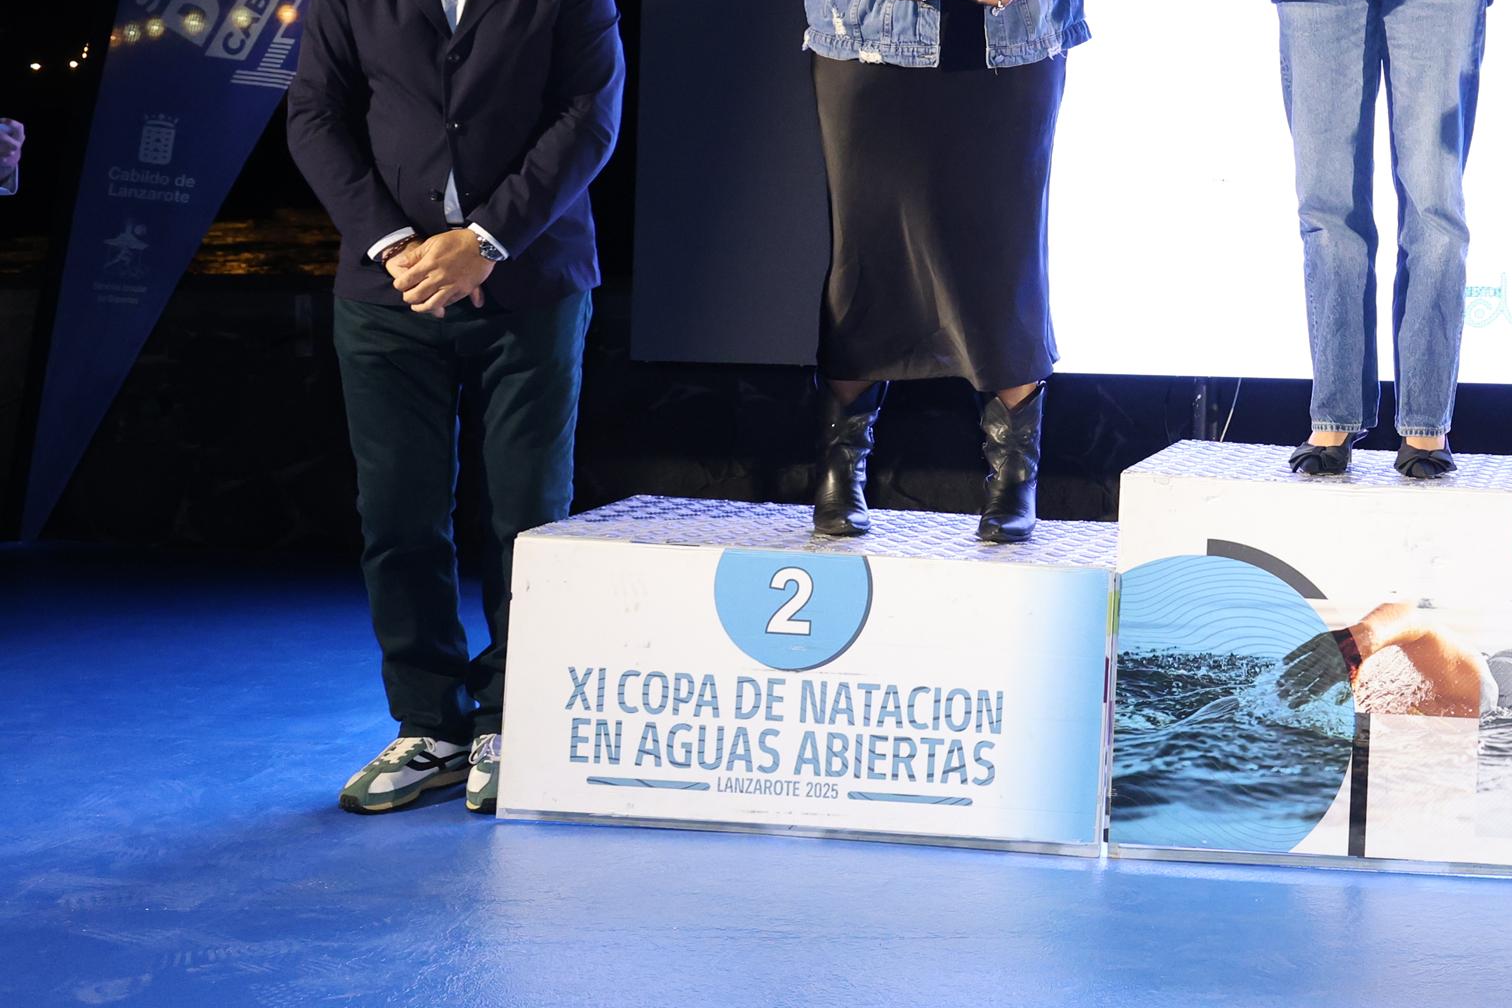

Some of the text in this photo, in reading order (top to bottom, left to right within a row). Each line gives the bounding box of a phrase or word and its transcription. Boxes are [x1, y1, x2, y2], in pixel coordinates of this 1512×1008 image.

[107, 183, 190, 204] Lanzarote
[108, 166, 196, 188] Cabildo de
[764, 566, 814, 636] 2
[565, 666, 1005, 734] XI COPA DE NATACION
[569, 717, 996, 787] EN AGUAS ABIERTAS
[716, 776, 839, 800] LANZAROTE 2025
